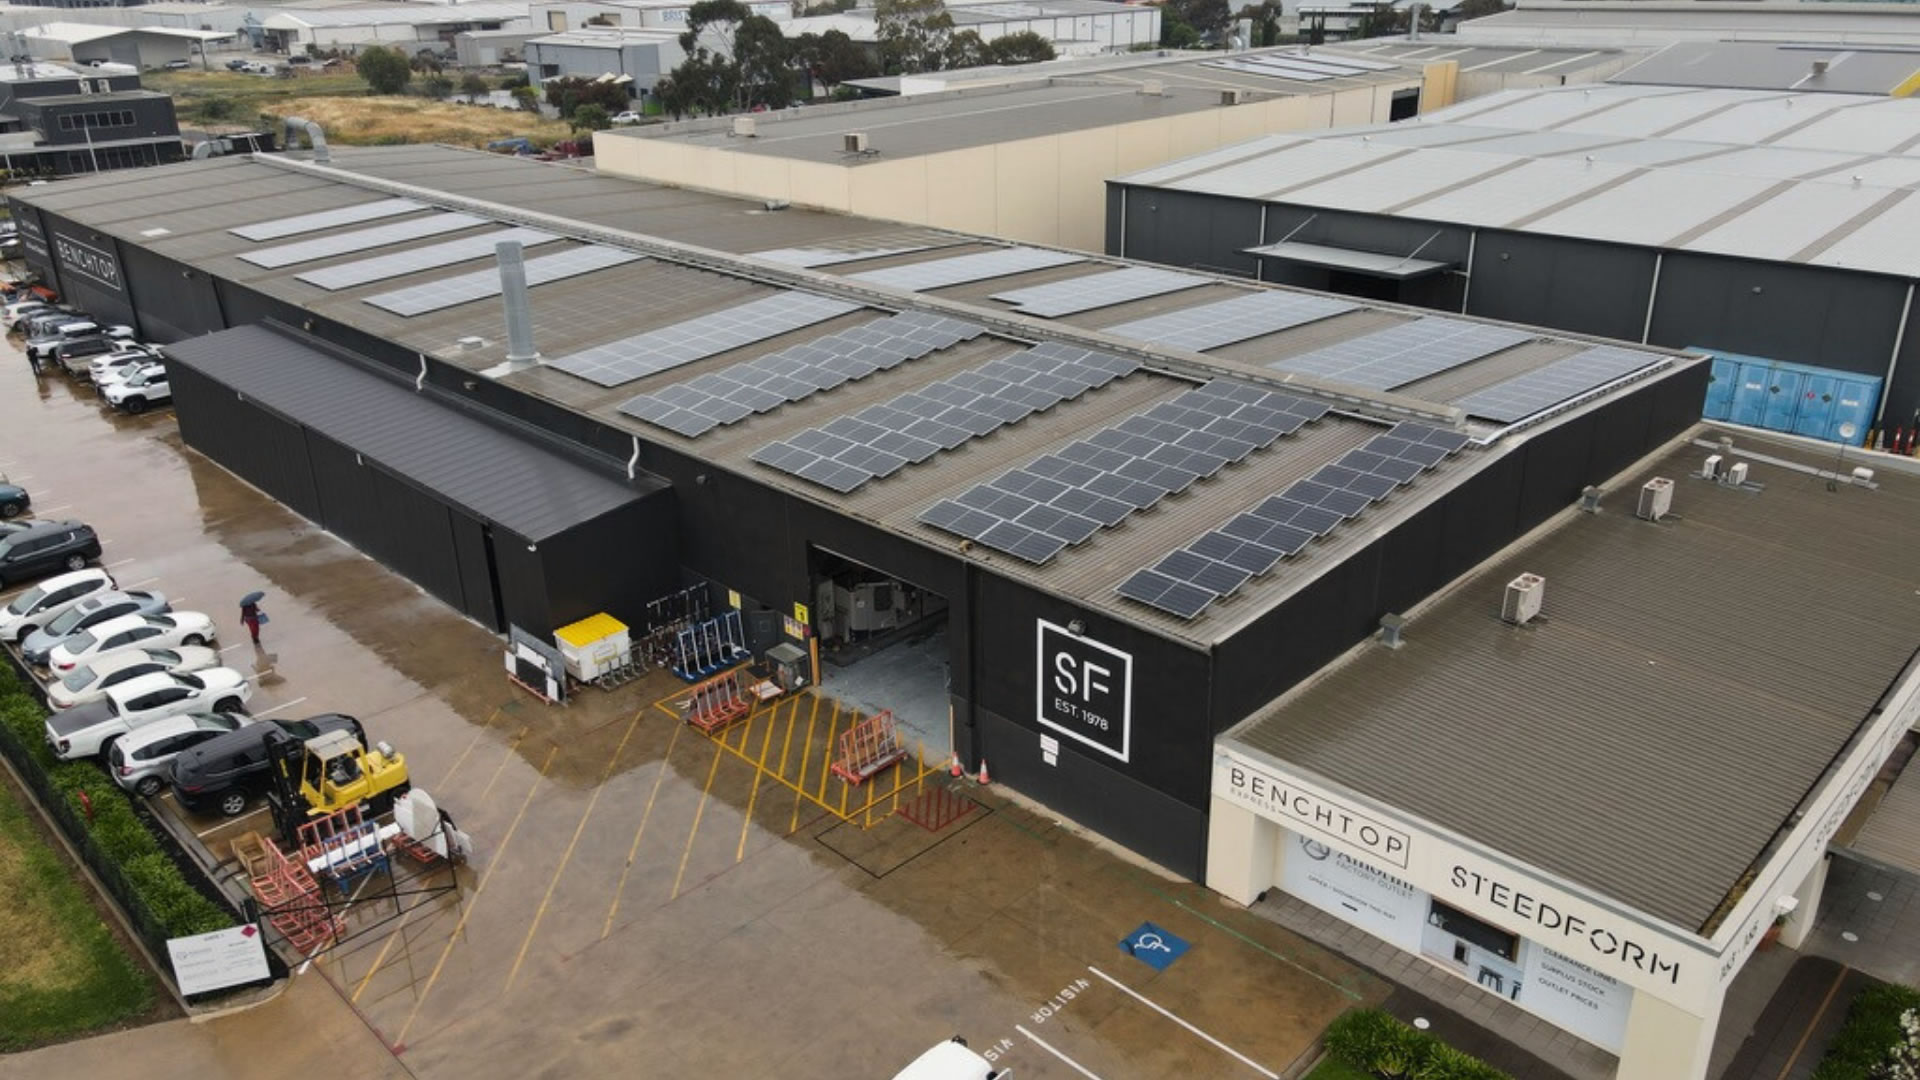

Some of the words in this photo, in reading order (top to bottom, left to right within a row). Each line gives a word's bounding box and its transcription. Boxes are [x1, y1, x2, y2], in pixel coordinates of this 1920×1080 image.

[56, 239, 115, 280] BENCHTOP
[1055, 651, 1111, 702] SF
[1055, 697, 1080, 719] EST.
[1081, 709, 1109, 731] 1978
[1231, 768, 1402, 852] BENCHTOP
[1377, 877, 1414, 900] OUTLET
[1451, 865, 1680, 984] STEEDFORM
[1541, 961, 1576, 983] SURPLUS
[1578, 979, 1605, 995] STOCK
[1543, 947, 1592, 972] CLEARANCE
[1593, 970, 1617, 985] LINES
[1029, 978, 1091, 1025] VISITOR
[1539, 978, 1568, 994] OUTLET
[1571, 993, 1598, 1009] PRICES
